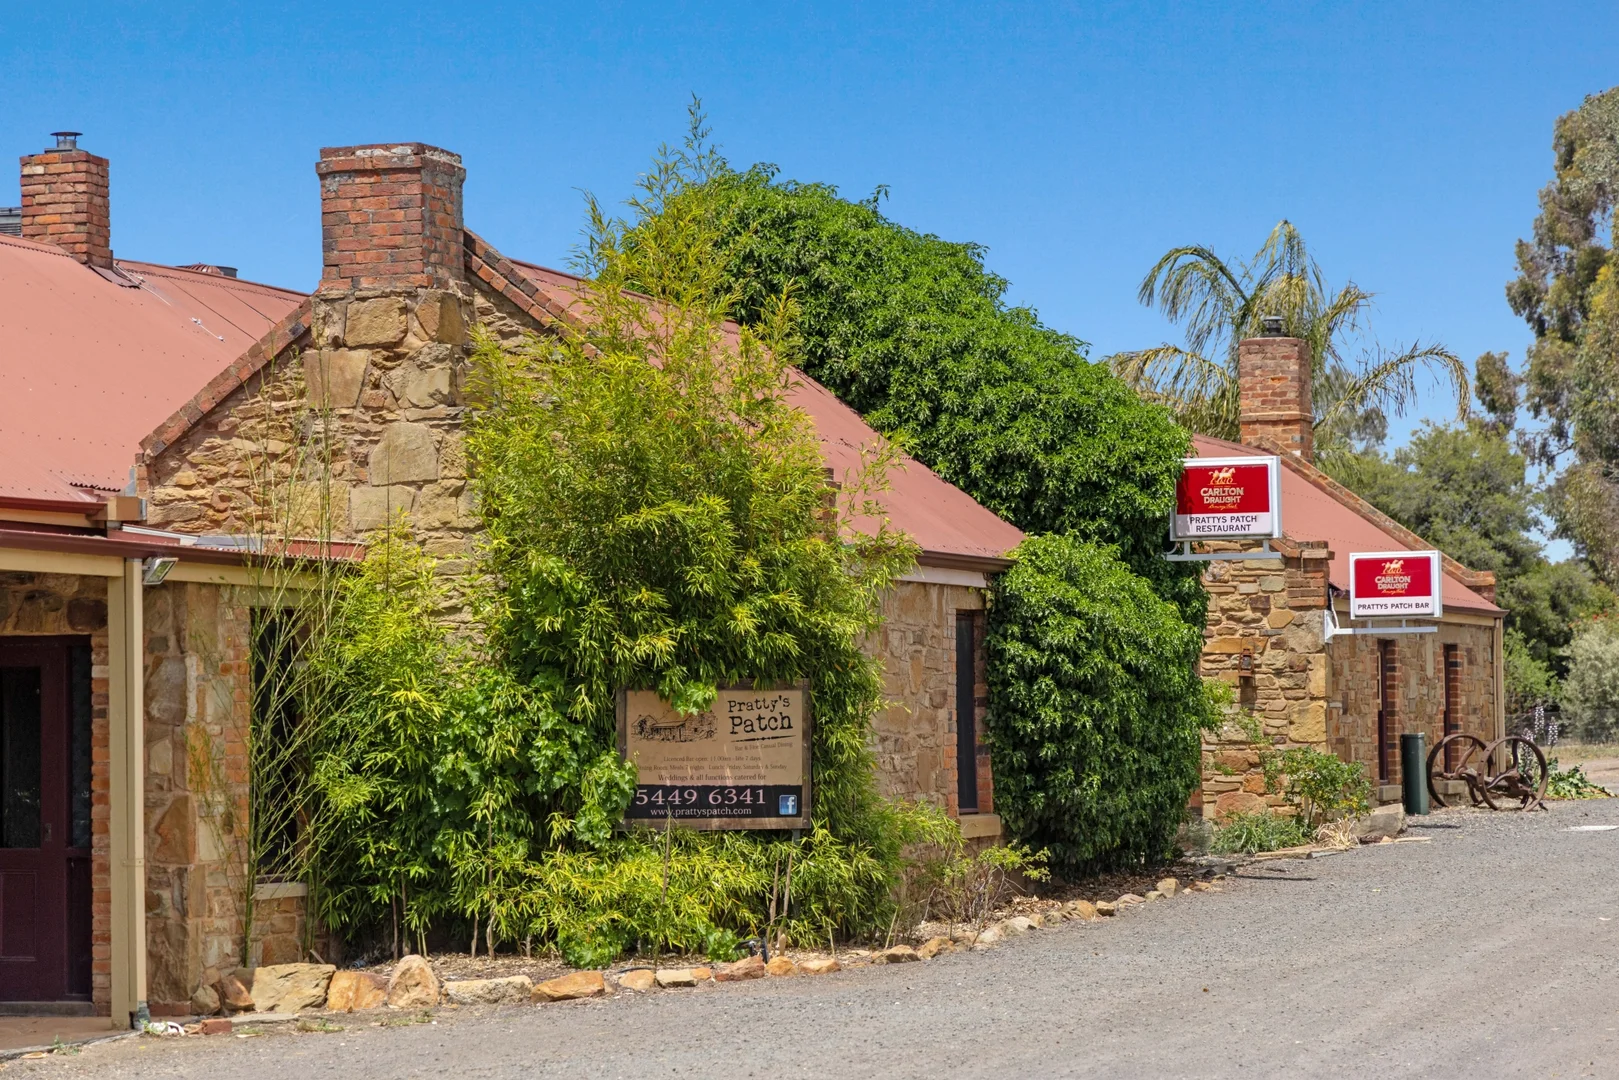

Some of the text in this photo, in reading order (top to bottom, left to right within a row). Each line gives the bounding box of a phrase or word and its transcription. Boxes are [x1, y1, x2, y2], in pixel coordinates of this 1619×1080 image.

[1200, 487, 1244, 496] CARLTON
[1203, 496, 1242, 504] DRAUGHT
[1190, 515, 1257, 524] PRATTYS PATCH
[1195, 524, 1251, 532] RESTAURANT
[1374, 575, 1411, 583] CARLTON
[727, 695, 791, 713] Pratty's
[728, 712, 793, 734] Patch
[658, 774, 688, 782] Weddings
[636, 788, 766, 805] 5449 6341
[650, 808, 752, 817] www.prattyspatch.com
